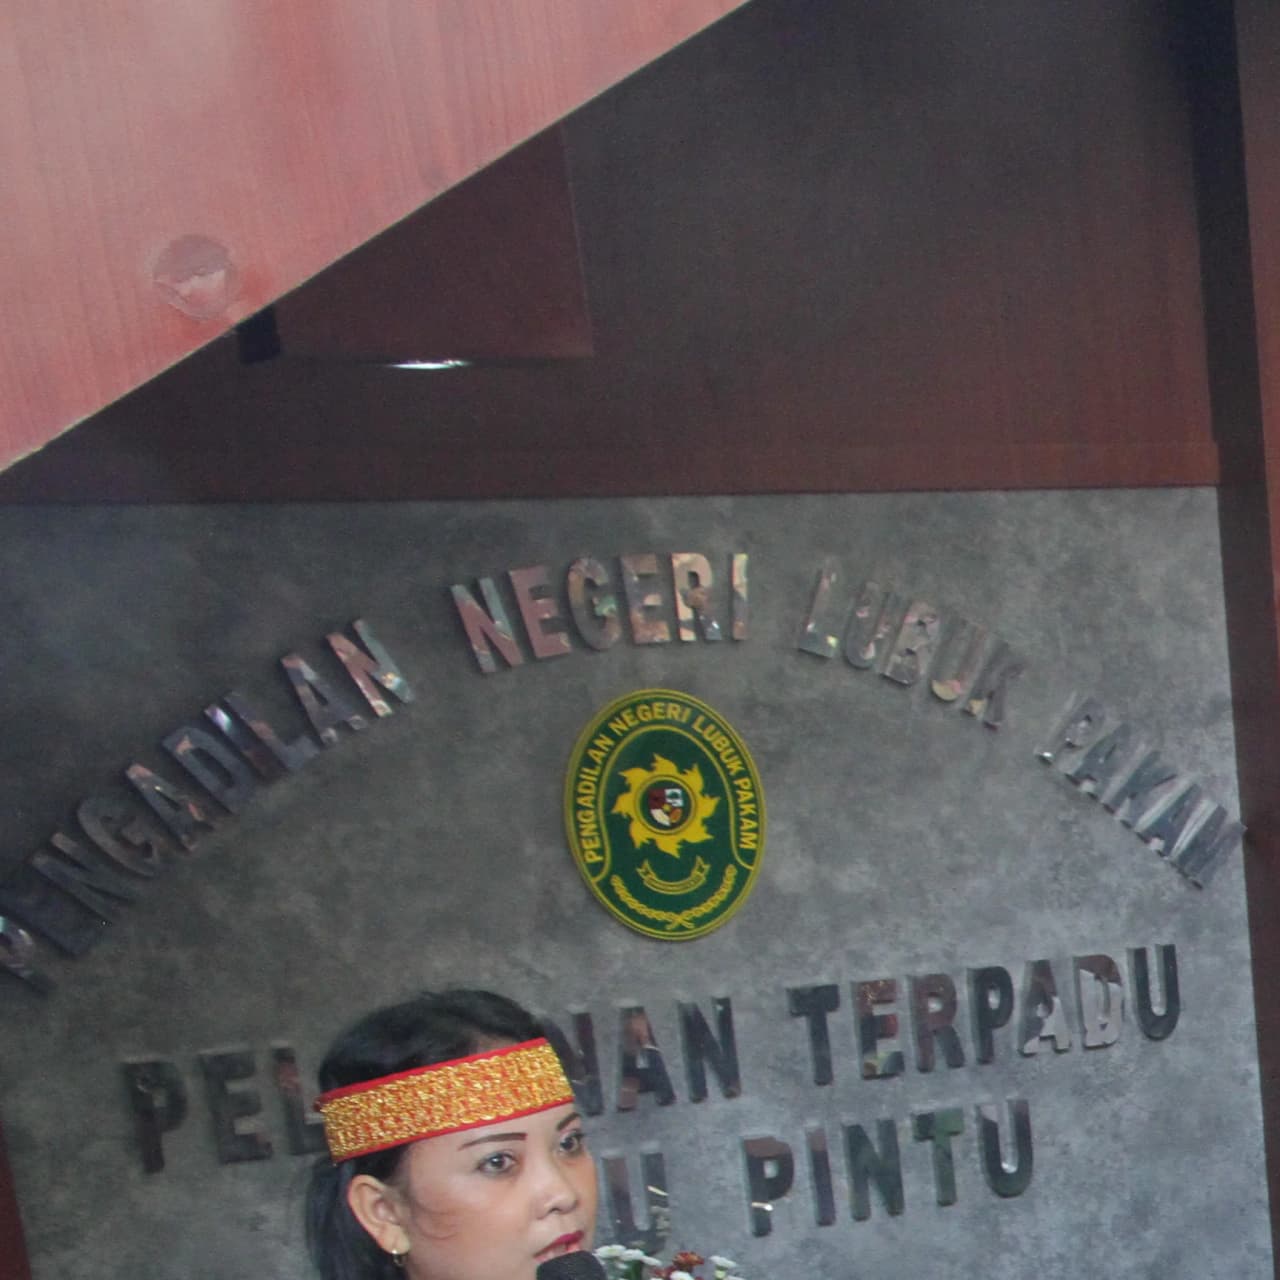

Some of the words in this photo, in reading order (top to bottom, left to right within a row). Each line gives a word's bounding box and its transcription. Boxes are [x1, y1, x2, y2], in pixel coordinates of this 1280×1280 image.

[450, 552, 749, 673] NEGERI
[799, 553, 1026, 730] LUBUK
[1034, 693, 1247, 890] PAKAM
[578, 735, 614, 863] PENGADILAN
[608, 702, 692, 736] NEGERI
[692, 716, 745, 776] LUBUK
[733, 778, 758, 850] PAKAM
[785, 942, 1181, 1086] TERPADU
[737, 1097, 1036, 1238] PINTU
